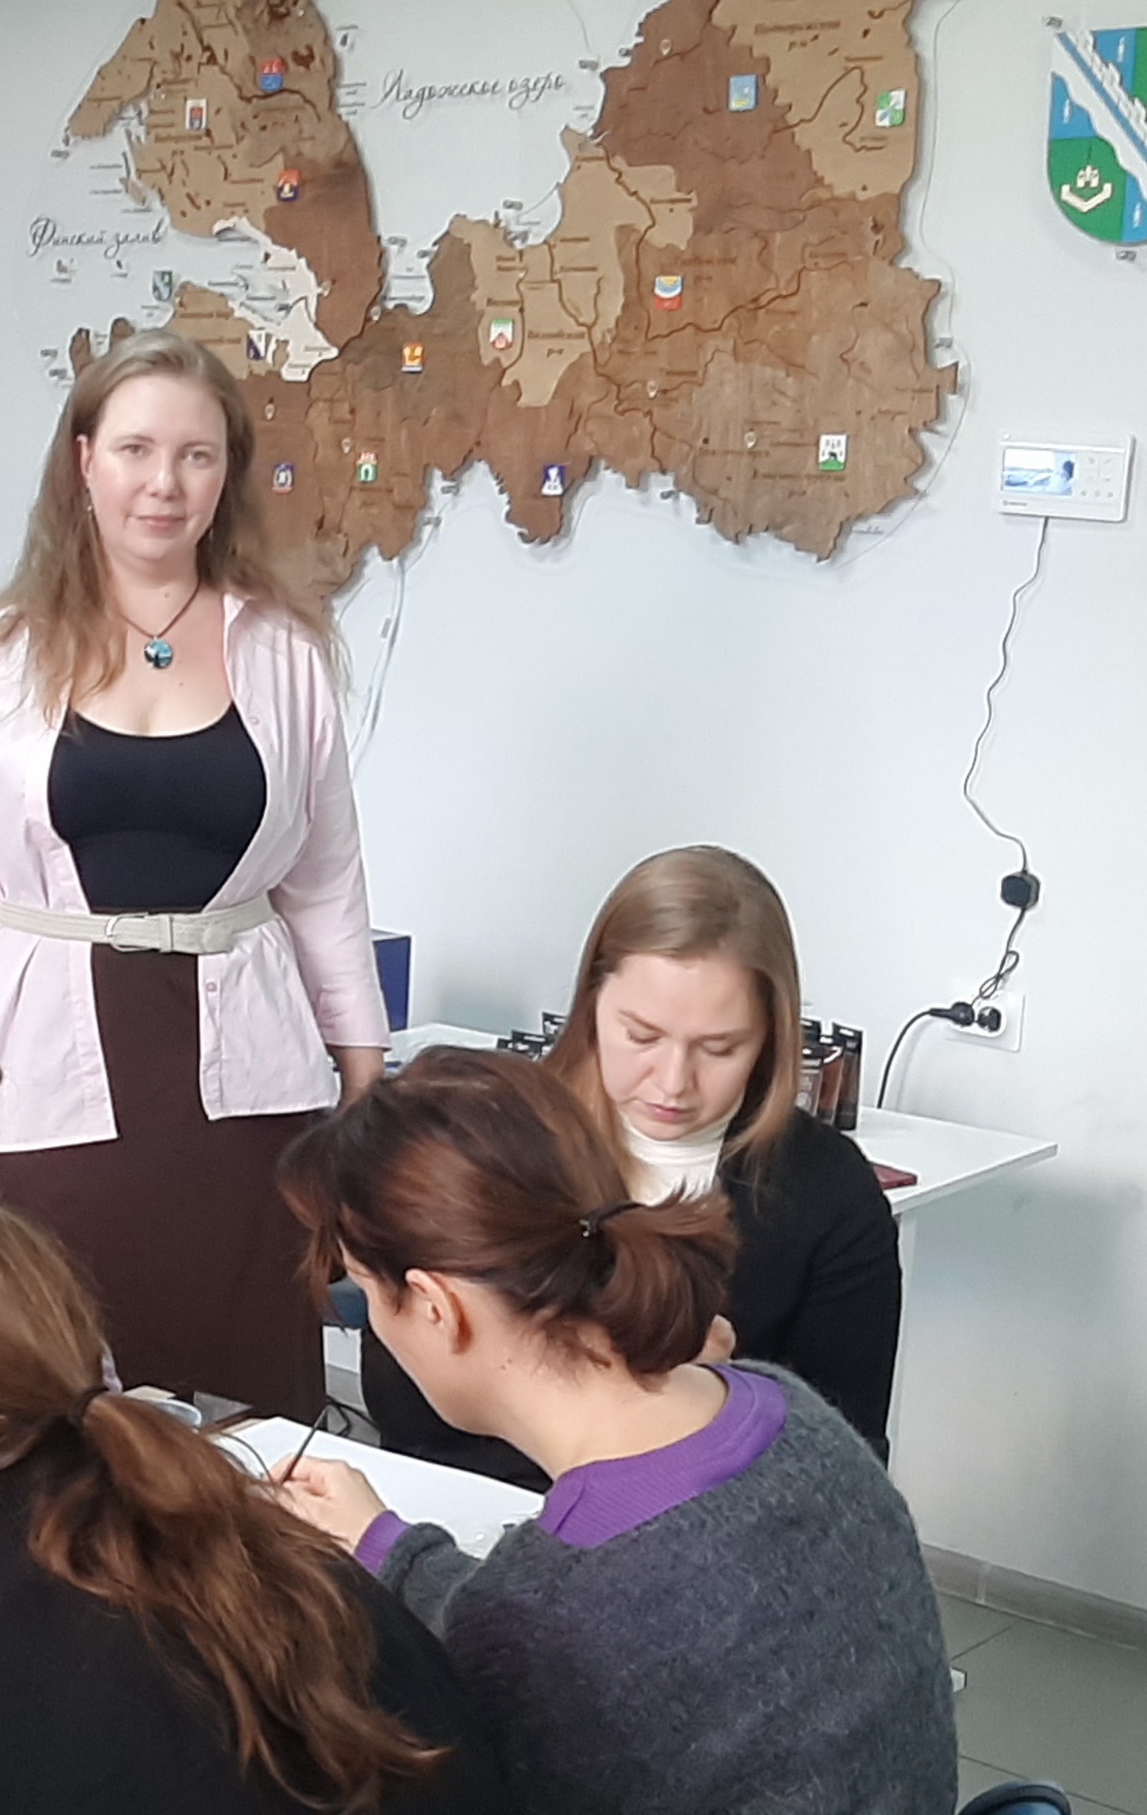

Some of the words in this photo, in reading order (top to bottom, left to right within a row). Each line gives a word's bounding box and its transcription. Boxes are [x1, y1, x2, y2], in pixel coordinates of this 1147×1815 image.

[370, 68, 501, 120] Ладожское
[508, 71, 566, 110] озеро
[29, 216, 106, 258] Финский
[104, 217, 169, 259] залив
